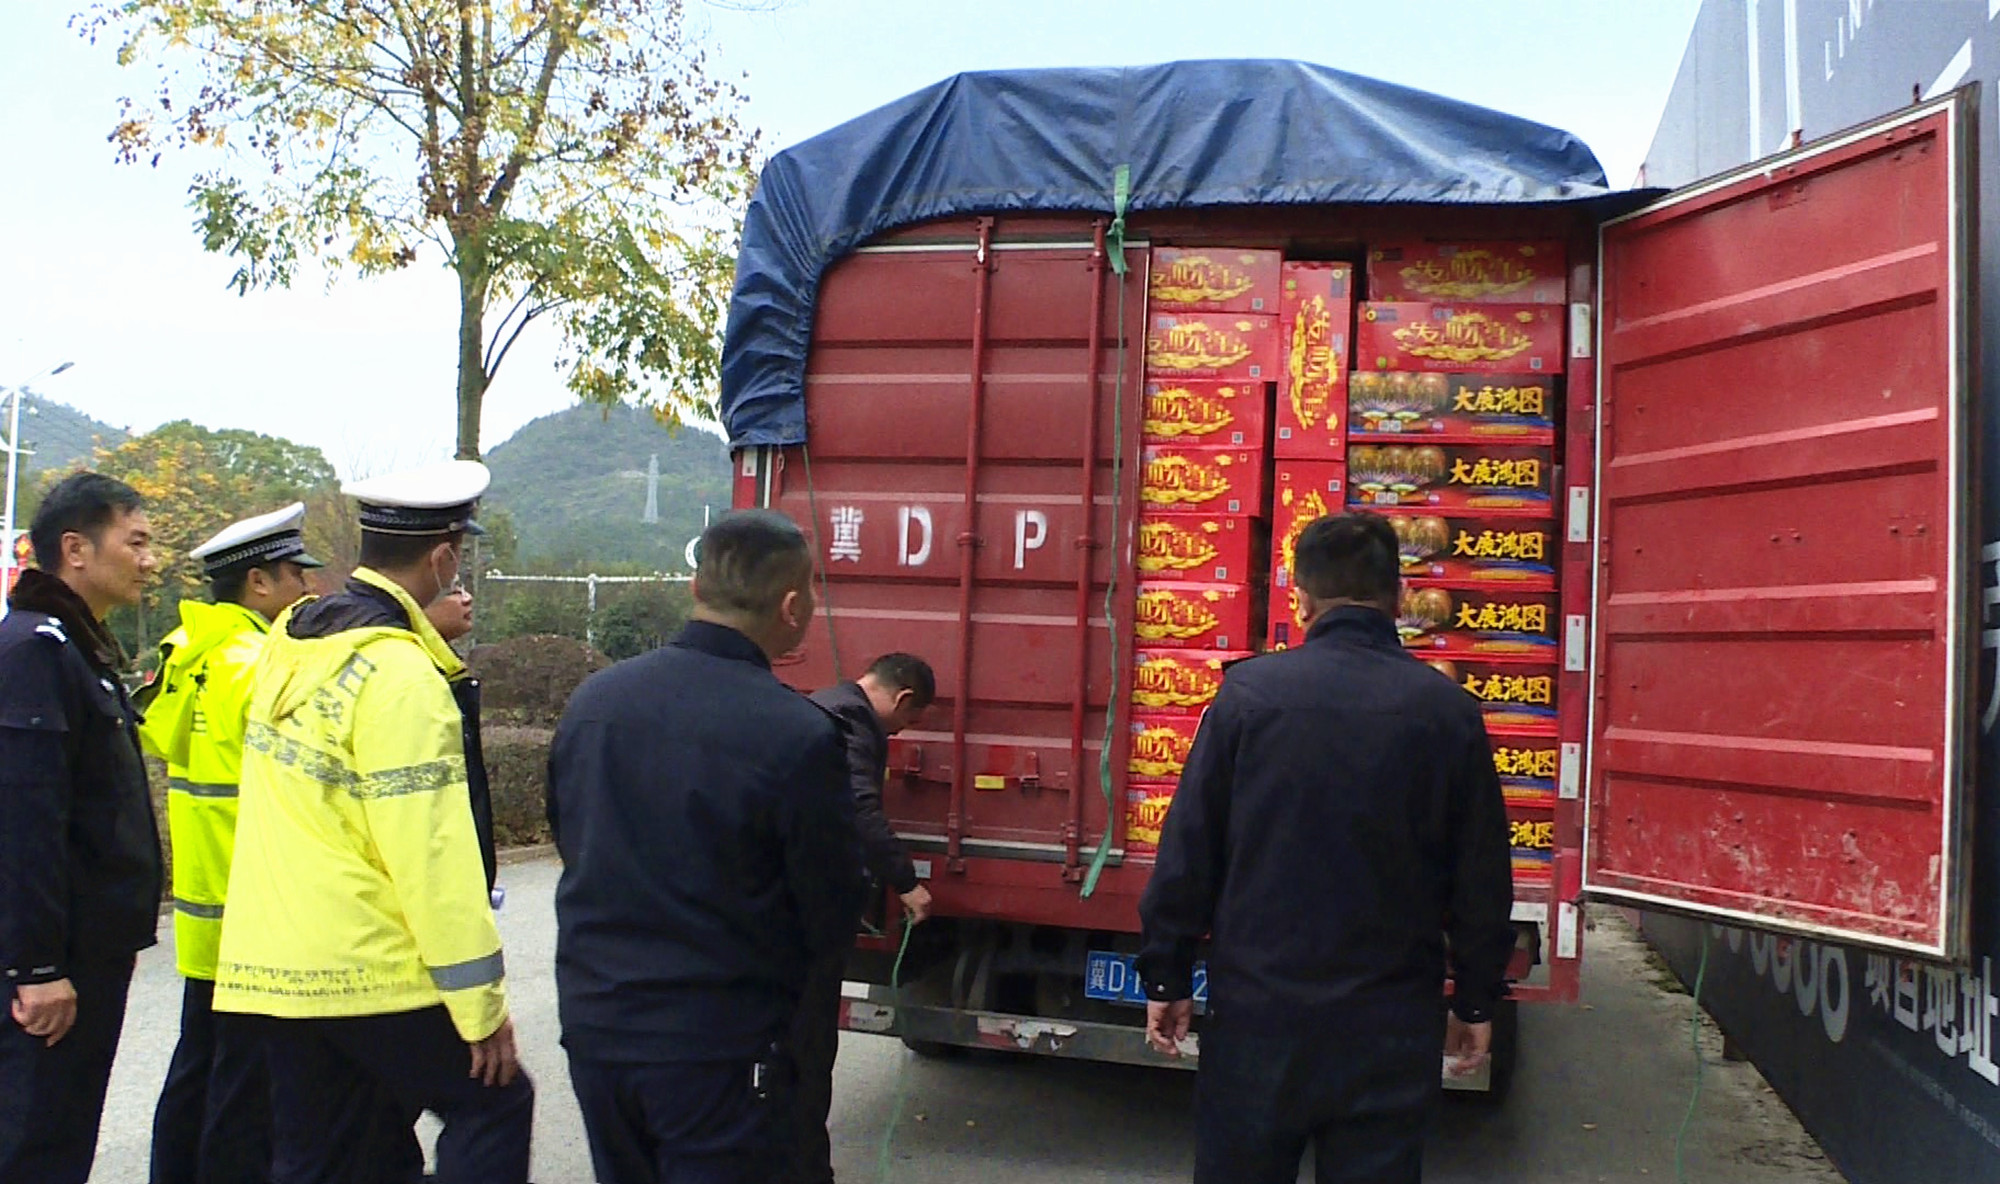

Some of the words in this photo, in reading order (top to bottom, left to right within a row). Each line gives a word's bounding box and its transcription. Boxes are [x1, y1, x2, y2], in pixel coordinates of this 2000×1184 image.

[1453, 385, 1544, 415] 大展鸿图
[1449, 457, 1539, 488] 大展鸿图
[1453, 529, 1544, 560] 大展鸿图
[1455, 602, 1547, 633] 大展鸿图
[1462, 674, 1552, 705] 大展鸿图
